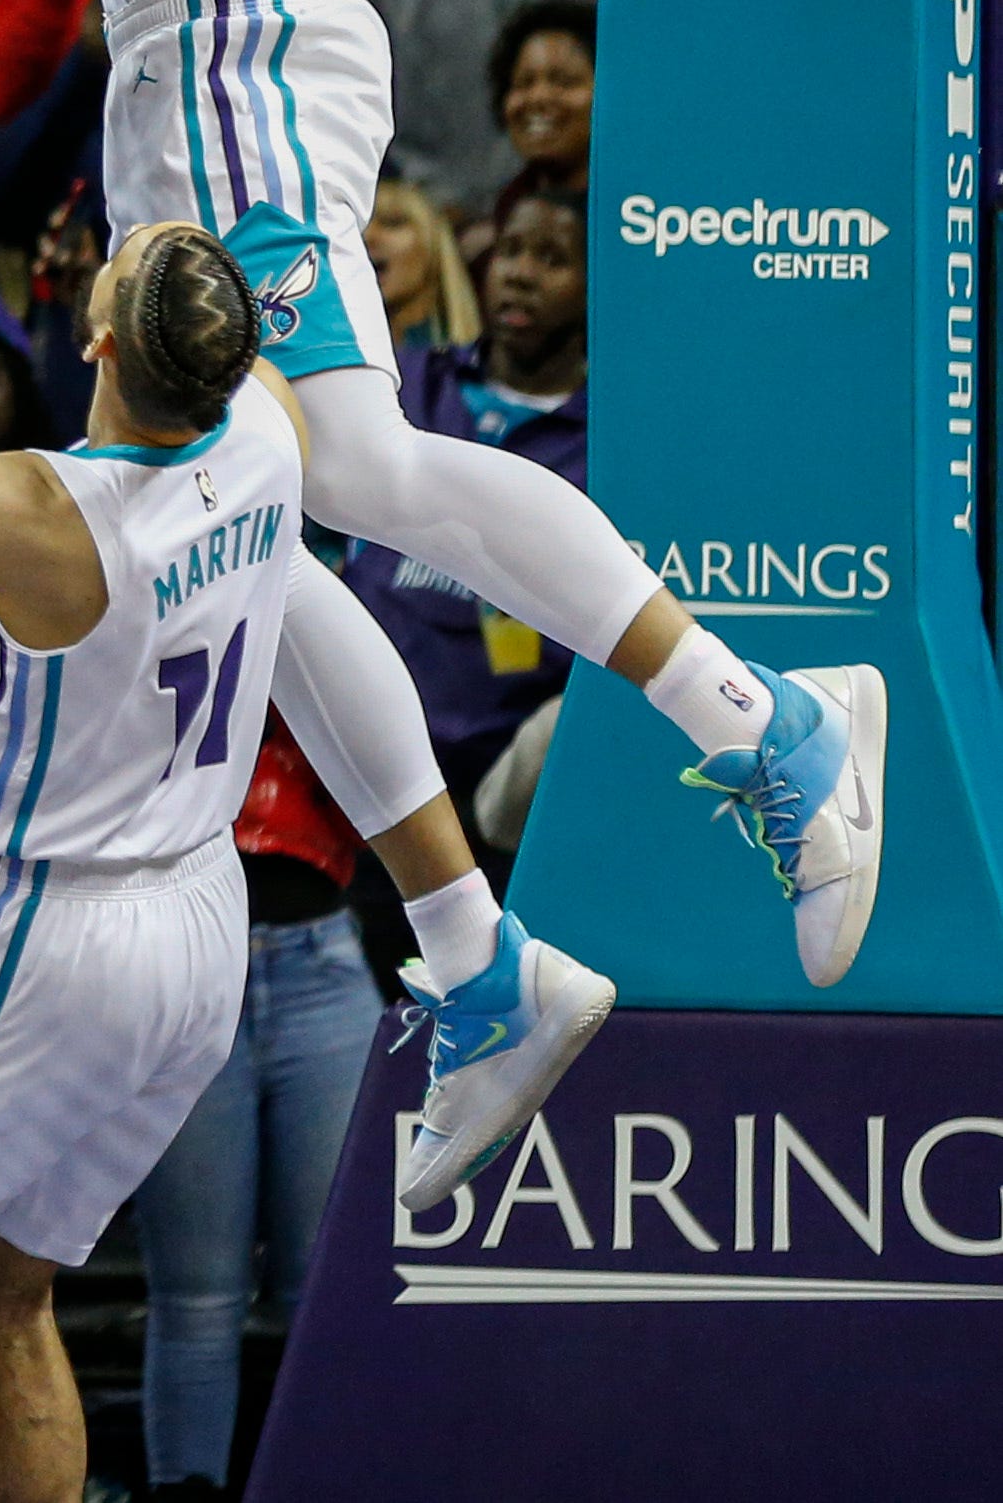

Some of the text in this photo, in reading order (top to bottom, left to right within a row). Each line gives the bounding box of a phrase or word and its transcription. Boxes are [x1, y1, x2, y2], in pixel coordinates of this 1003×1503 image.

[619, 193, 872, 258] Spectrum
[753, 252, 870, 281] CENTER
[947, 152, 975, 539] SECURITY
[152, 503, 285, 623] MARTIN
[626, 539, 892, 601] ARINGS
